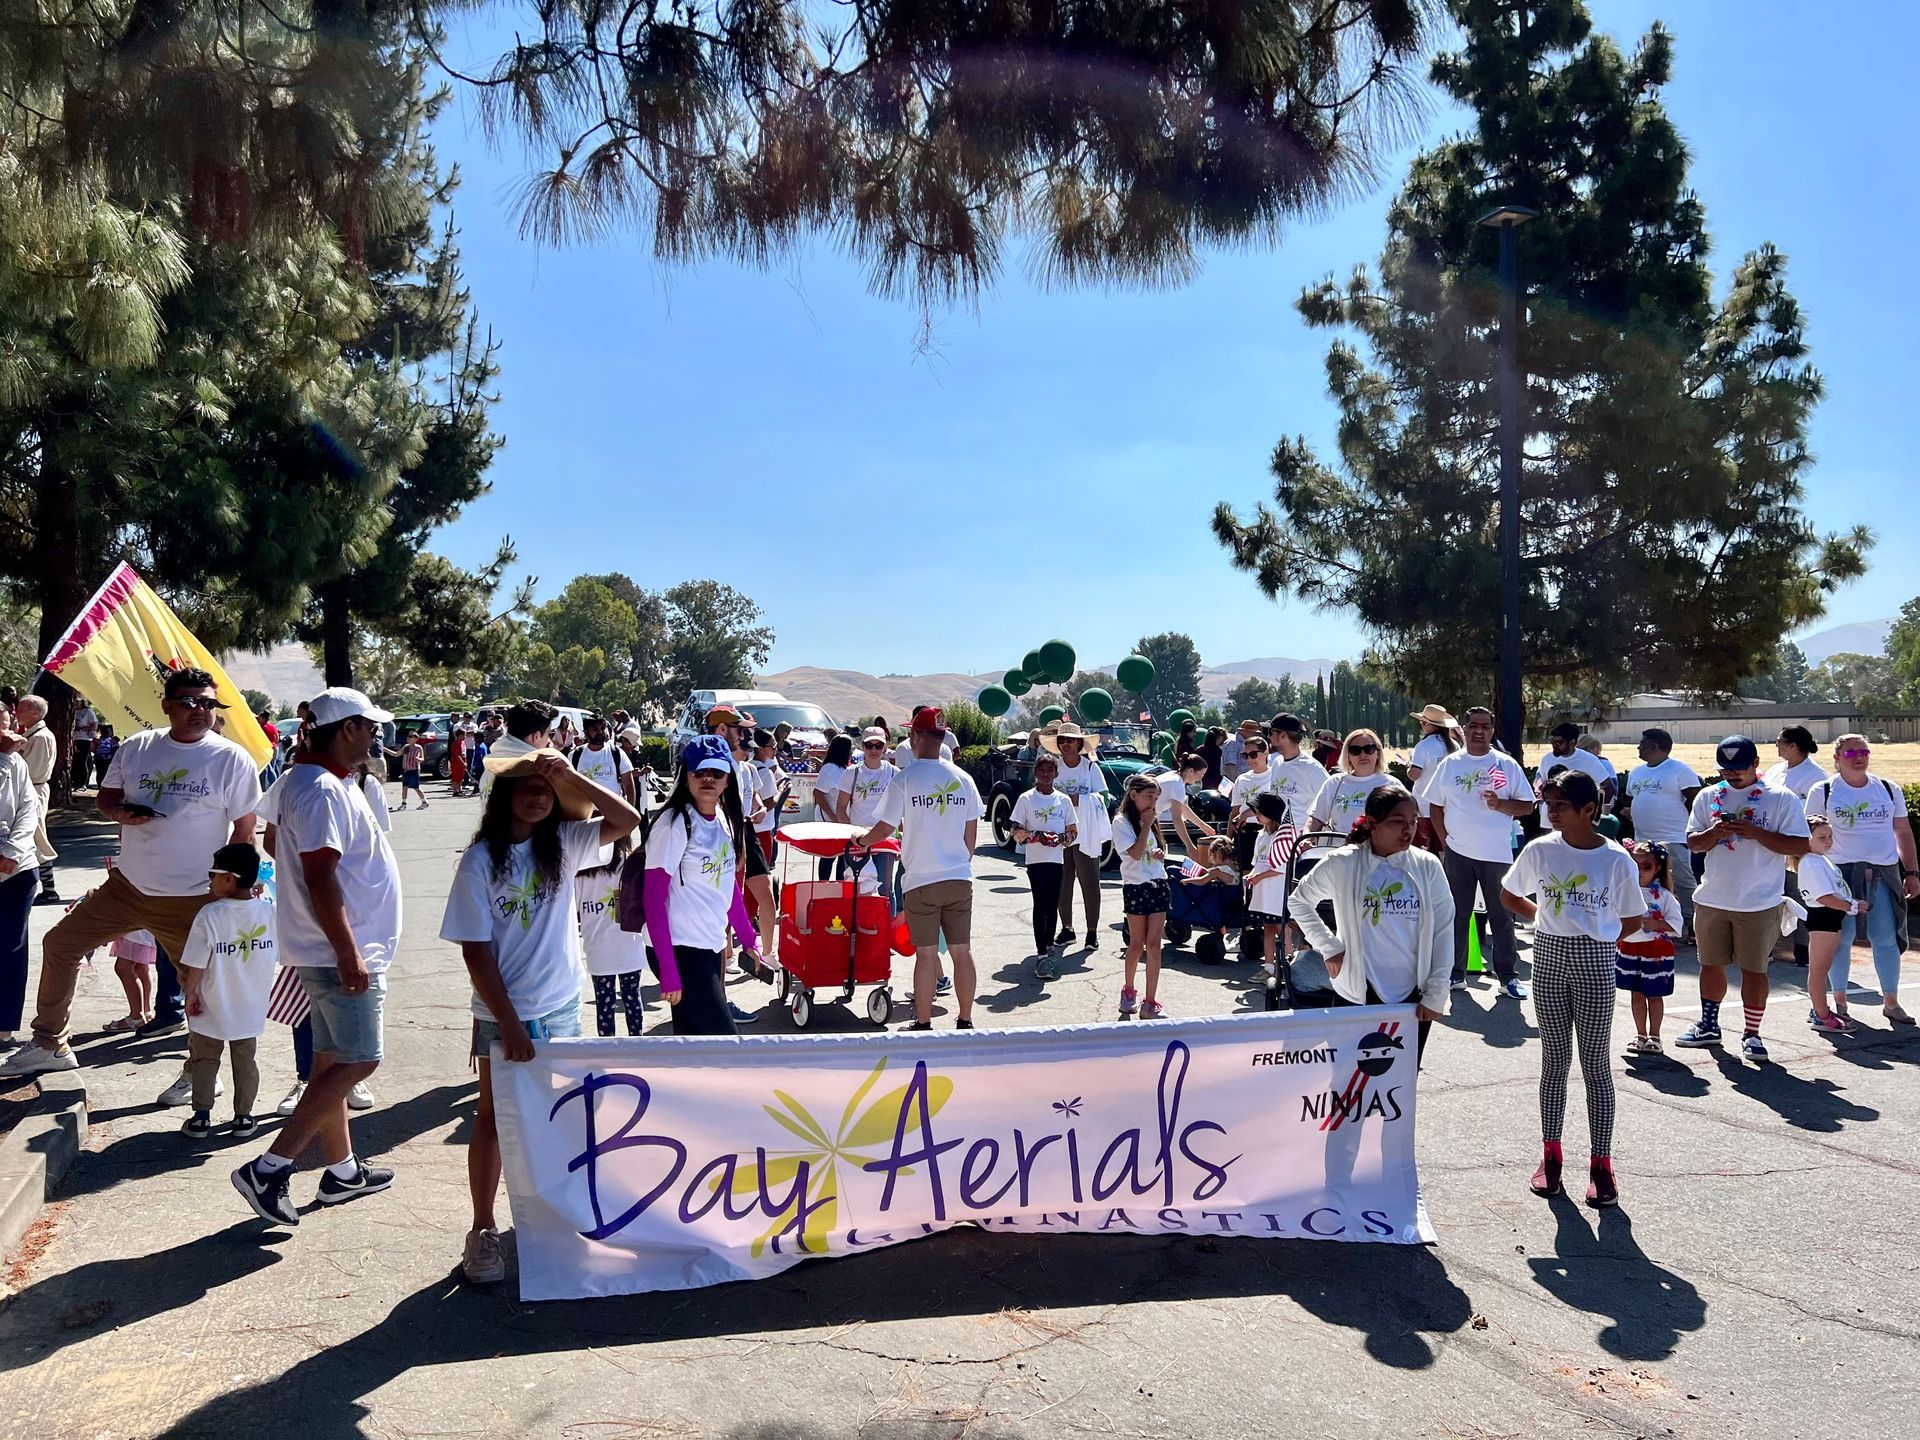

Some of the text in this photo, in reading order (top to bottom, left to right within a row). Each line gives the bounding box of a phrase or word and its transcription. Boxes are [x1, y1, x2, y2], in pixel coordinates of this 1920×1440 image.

[138, 773, 210, 799] Bay Aerials
[912, 794, 966, 808] Flip 4 Fun
[1835, 804, 1889, 826] Bay Aerials
[1567, 881, 1608, 908] Aerials
[494, 896, 528, 920] Bay
[582, 901, 604, 915] Flip
[1363, 898, 1380, 918] ay
[239, 941, 247, 951] 4
[251, 939, 273, 951] Fun
[1252, 1048, 1338, 1067] FREMONT
[1300, 1086, 1404, 1124] NINJAS
[549, 1040, 1244, 1254] Bay Aerials
